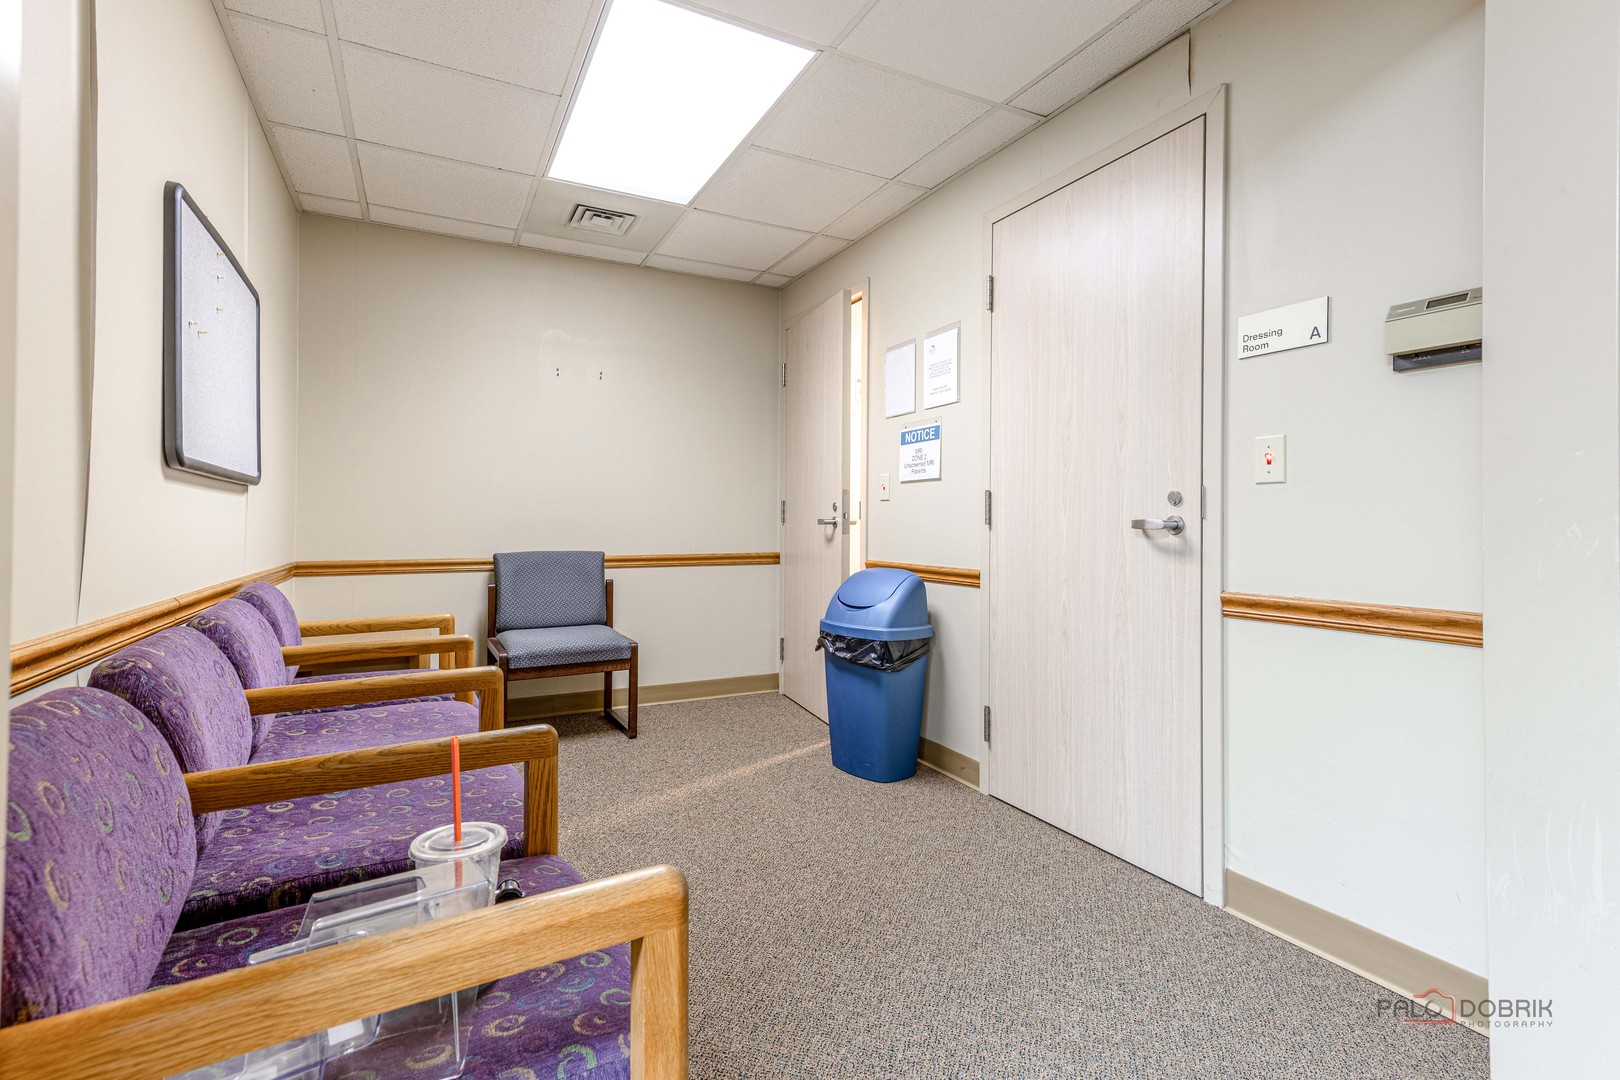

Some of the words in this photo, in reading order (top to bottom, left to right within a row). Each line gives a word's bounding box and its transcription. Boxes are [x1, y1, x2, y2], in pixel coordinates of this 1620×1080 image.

[1242, 328, 1283, 343] Dressing
[1309, 326, 1321, 340] A
[1242, 342, 1269, 353] Room
[905, 428, 935, 443] NOTICE
[911, 454, 923, 462] ZONE
[903, 461, 926, 469] Unscreened
